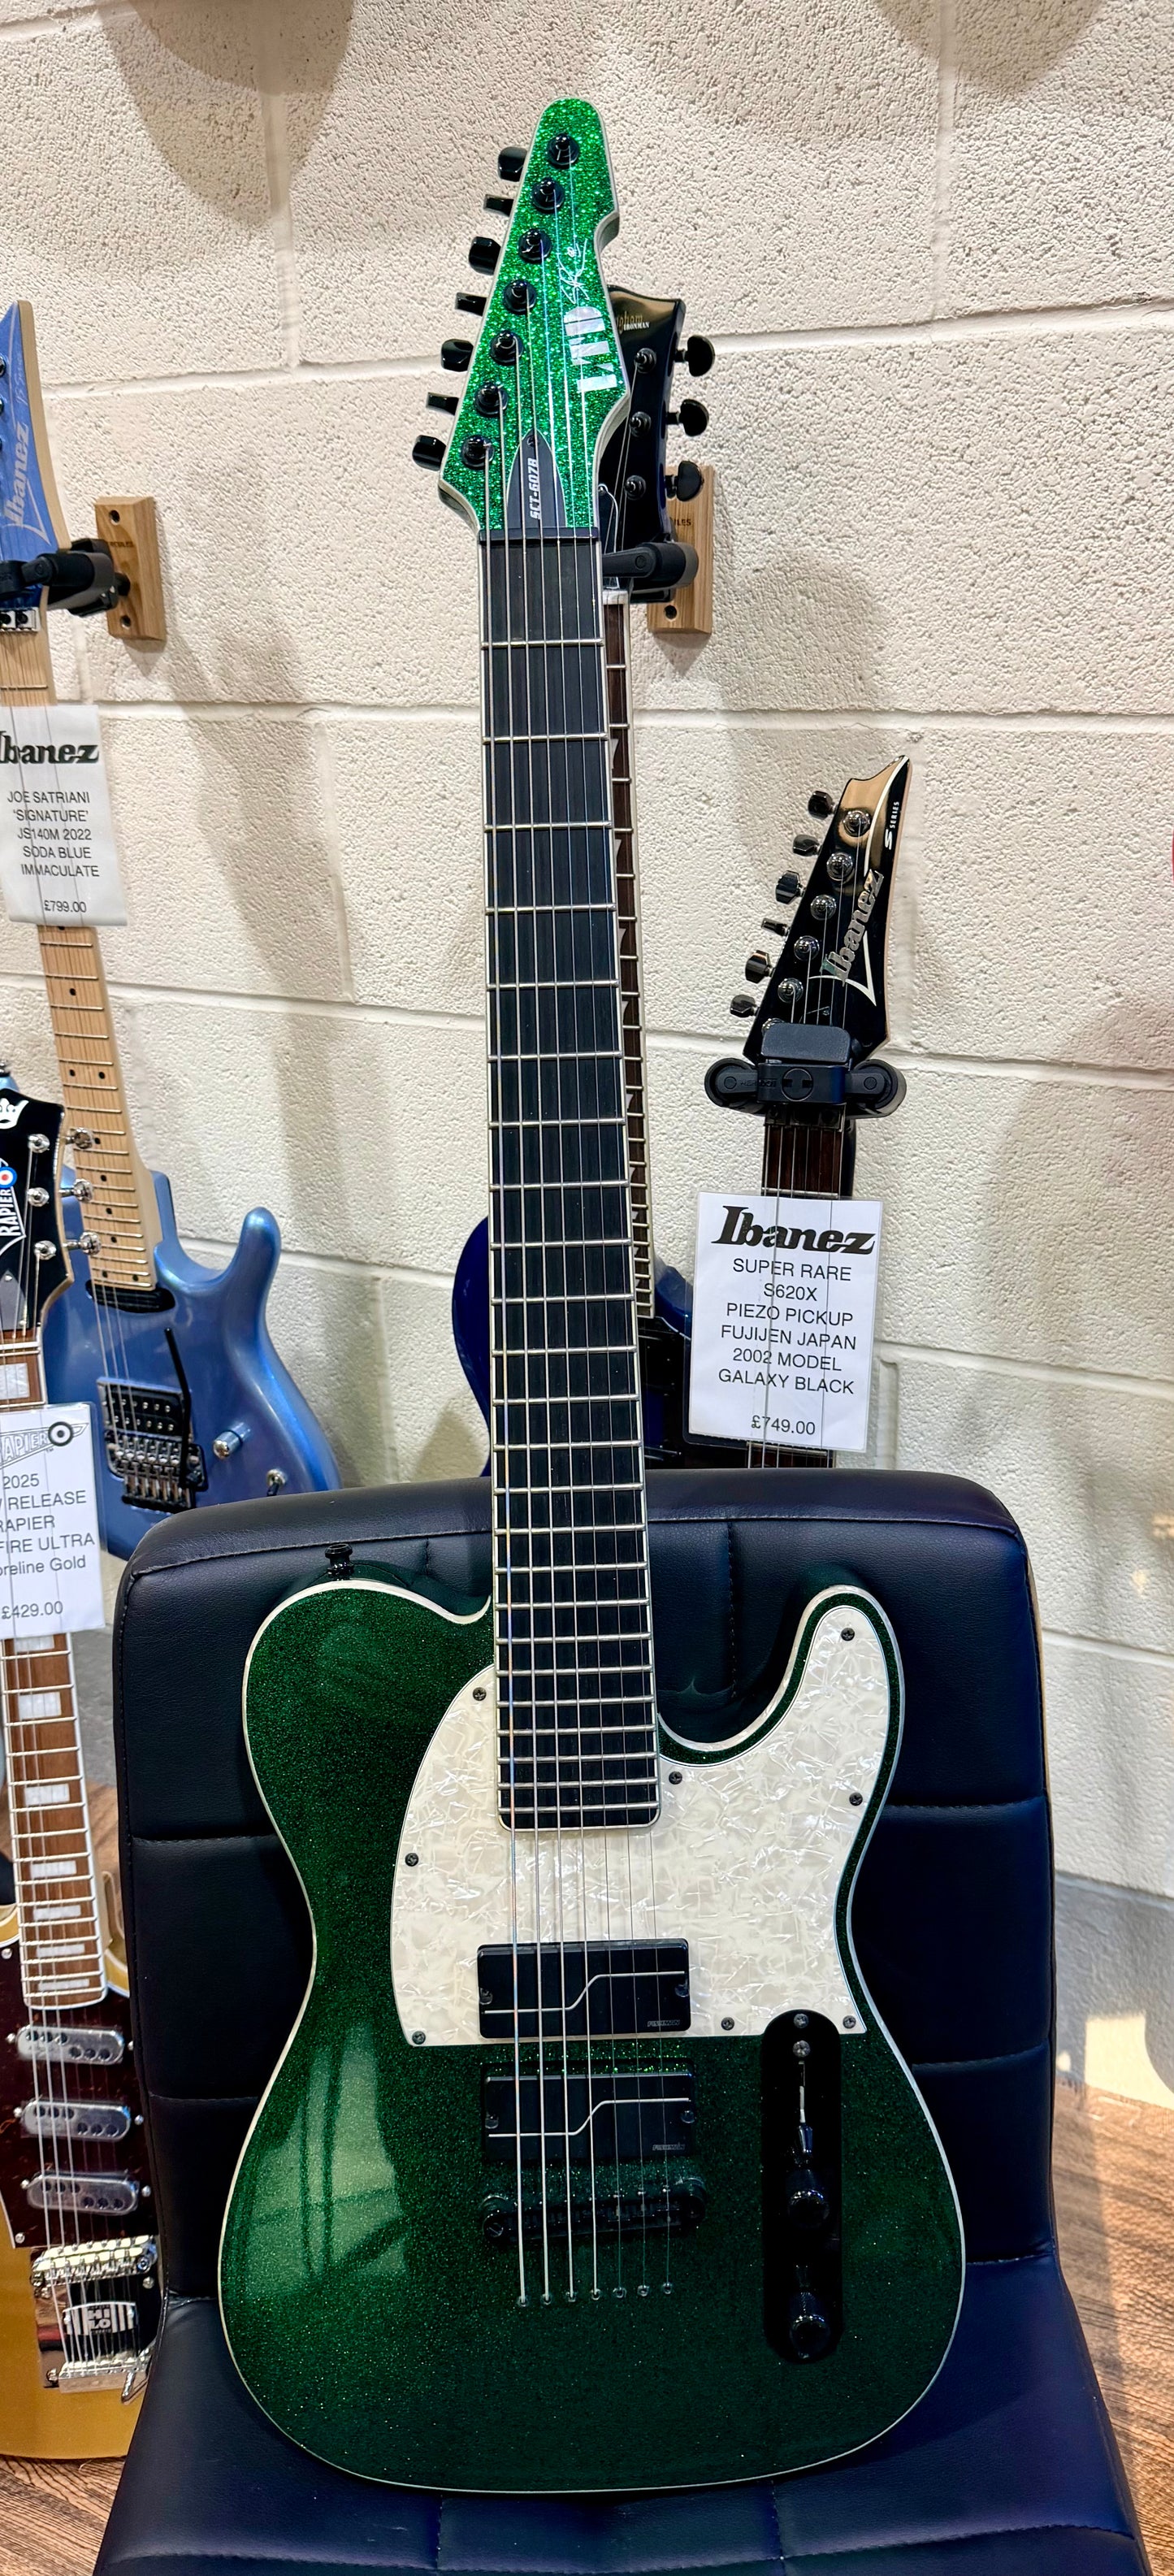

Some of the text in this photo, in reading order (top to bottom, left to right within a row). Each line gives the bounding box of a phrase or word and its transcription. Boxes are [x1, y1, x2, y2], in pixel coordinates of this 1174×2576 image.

[617, 310, 643, 335] gham
[563, 306, 617, 393] LTD
[3, 420, 30, 527] Ibanez
[674, 518, 691, 527] LES
[7, 791, 90, 804] JOE SATRIANI
[890, 801, 899, 829] SERIES
[18, 829, 92, 840] JS140M 2022
[23, 847, 92, 859] SODA BLUE
[21, 864, 100, 877] IMMACULATE
[44, 900, 87, 913] £799.00
[819, 869, 884, 987] Ibanez
[0, 1189, 22, 1235] RAPIER
[711, 1205, 876, 1255] Ibanez
[733, 1258, 852, 1281] SUPER RARE
[763, 1283, 818, 1302] S620X
[726, 1303, 853, 1327] PIEZO PICKUP
[721, 1325, 856, 1350] FUJIJEN JAPAN
[733, 1348, 842, 1372] 2002 MODEL
[718, 1368, 854, 1394] GALAXY BLACK
[752, 1415, 816, 1435] £749.00
[0, 1429, 47, 1461] APIER
[3, 1473, 39, 1490] 2025
[8, 1490, 86, 1511] RELEASE
[38, 1533, 95, 1551] ULTRA
[50, 1555, 85, 1572] Gold
[2, 1601, 63, 1620] £429.00
